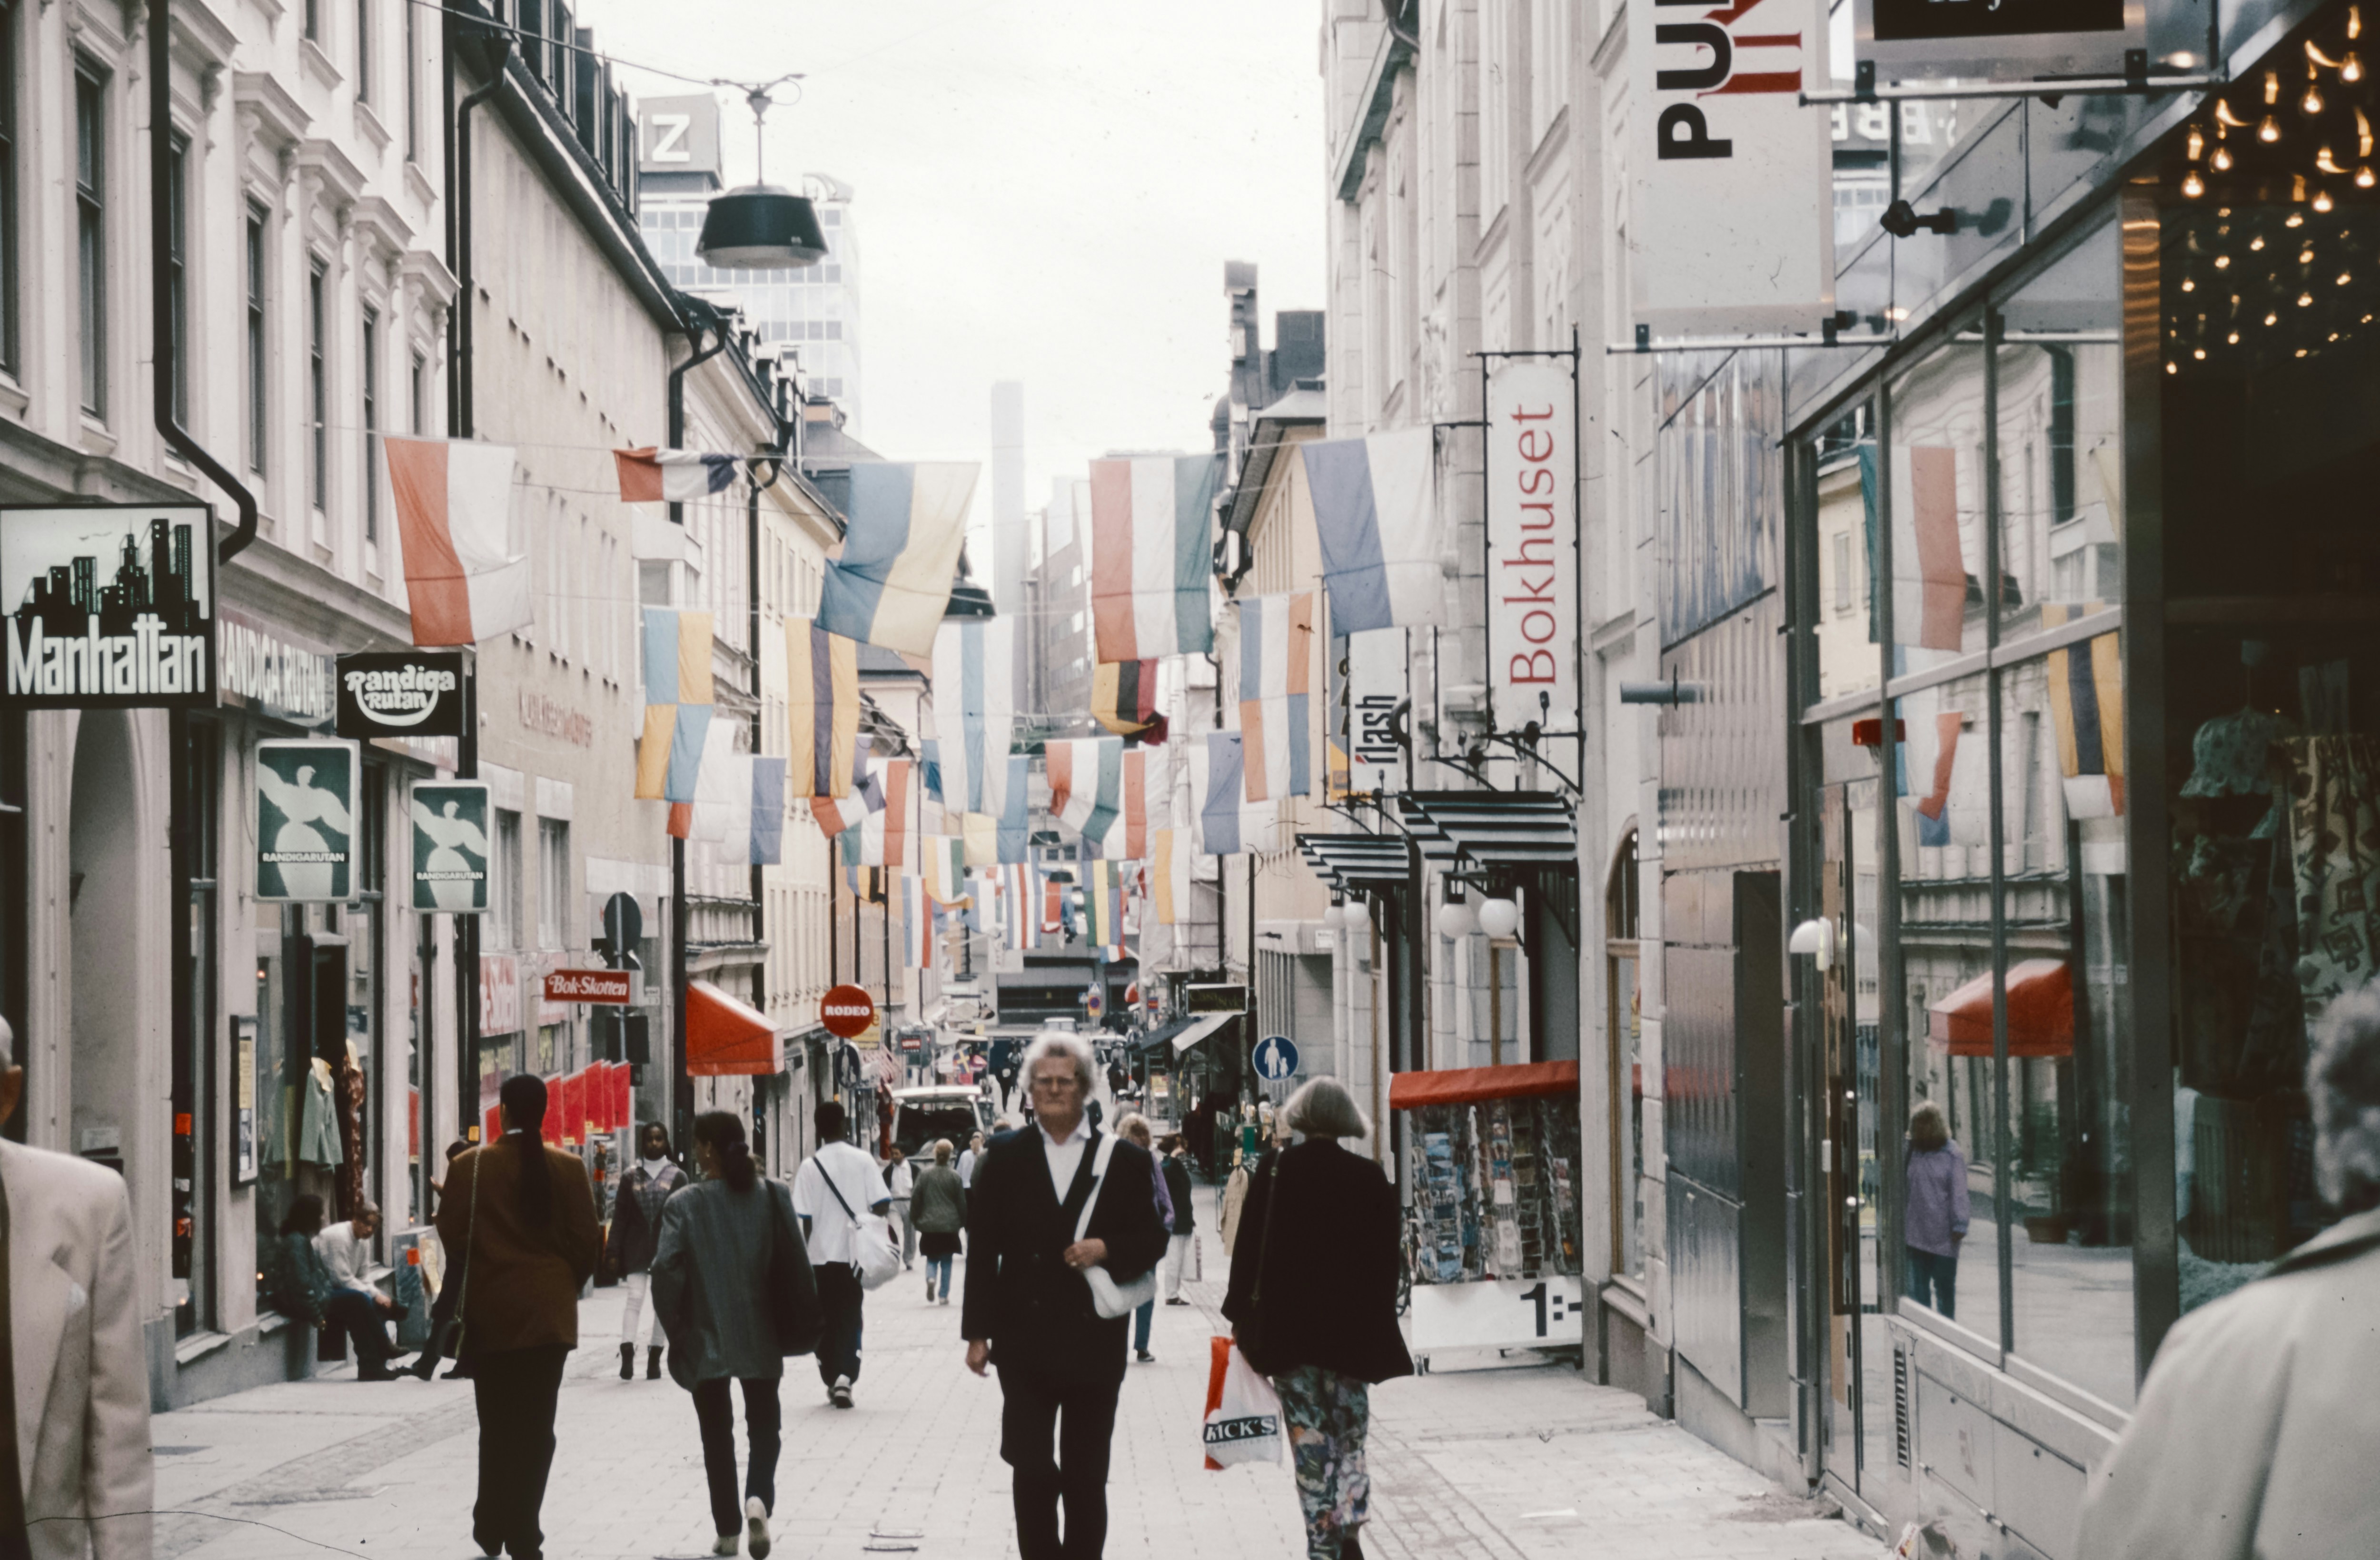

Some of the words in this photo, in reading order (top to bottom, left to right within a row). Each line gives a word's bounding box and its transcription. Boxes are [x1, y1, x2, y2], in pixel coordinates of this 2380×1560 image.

[1655, 0, 1732, 159] PU
[1502, 403, 1557, 685] Bokhuset
[7, 614, 206, 694] Manhattan
[344, 664, 456, 692] Randiga
[365, 691, 428, 710] Rutan
[1355, 695, 1398, 764] flash
[262, 853, 345, 862] RANDIGARUTAN
[416, 872, 484, 880] RANDIGARUTAN
[548, 974, 627, 996] Bok-Skotten
[825, 1006, 870, 1016] RODEO
